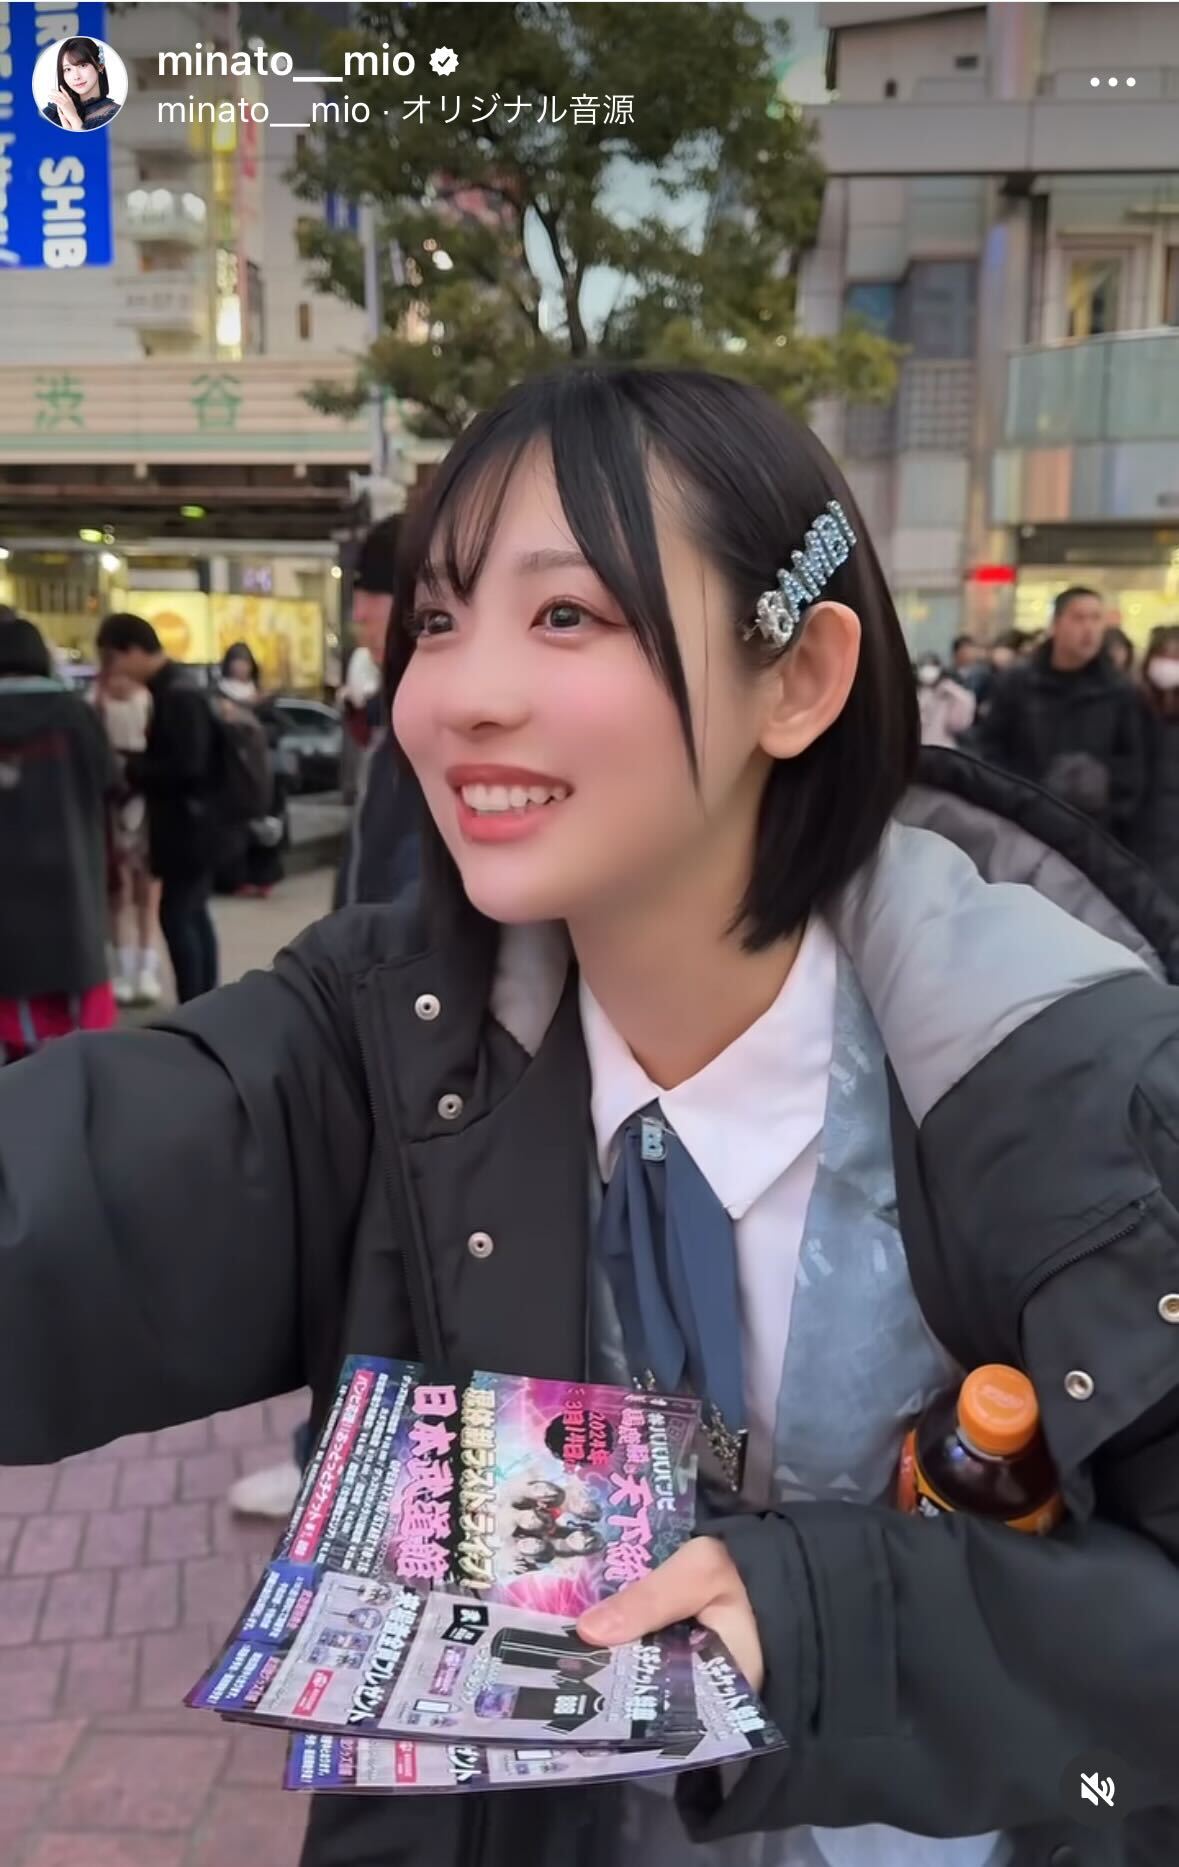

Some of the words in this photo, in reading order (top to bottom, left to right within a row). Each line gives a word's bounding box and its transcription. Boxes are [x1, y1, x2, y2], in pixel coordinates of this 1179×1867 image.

[396, 1385, 458, 1583] 日本武道館
[588, 1411, 609, 1466] 2024年
